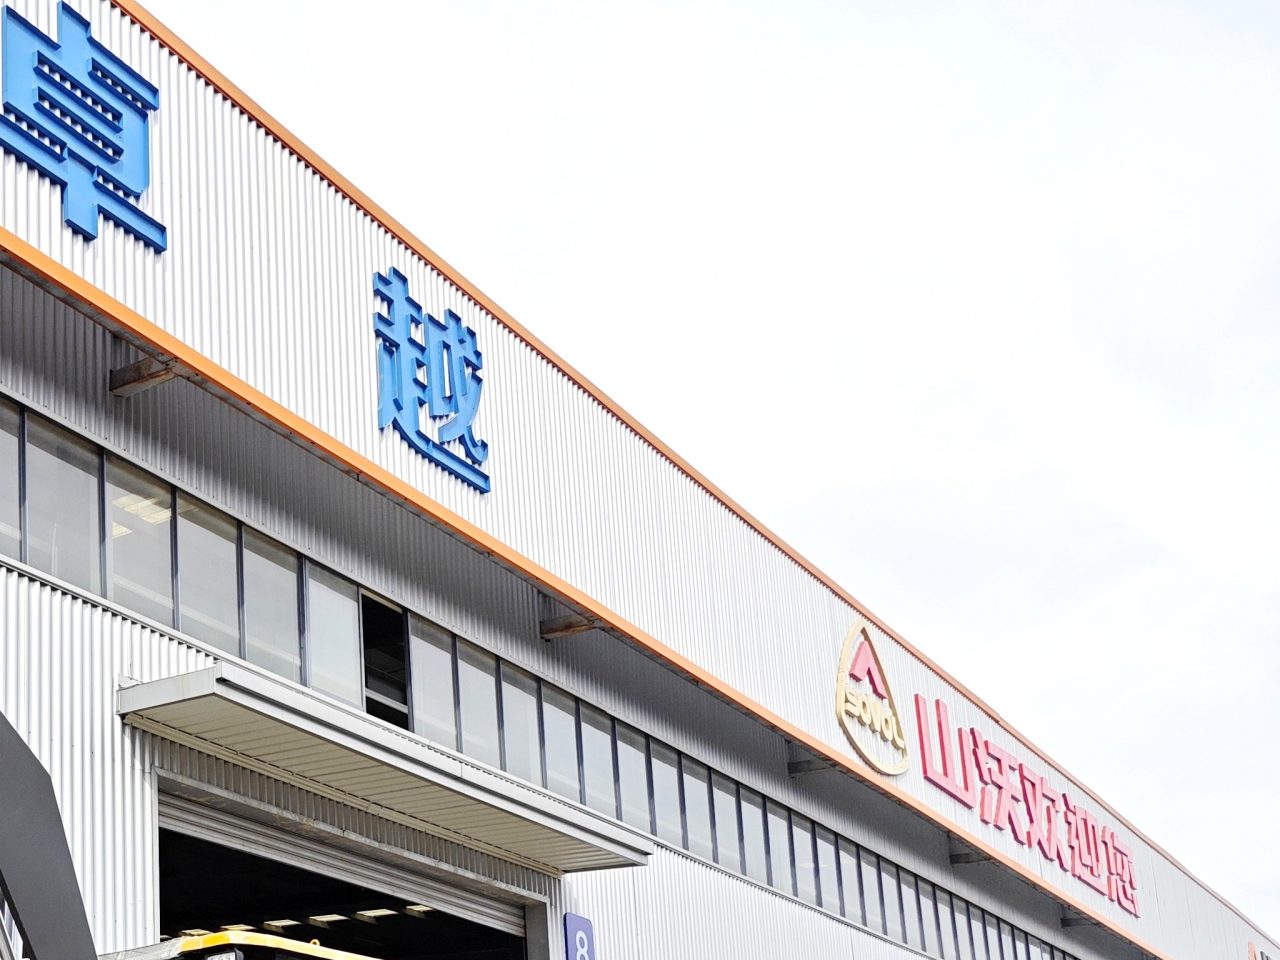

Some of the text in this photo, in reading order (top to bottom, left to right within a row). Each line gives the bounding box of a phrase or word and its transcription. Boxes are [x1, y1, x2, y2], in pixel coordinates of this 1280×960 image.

[913, 693, 1141, 918] 山沃欢迎您
